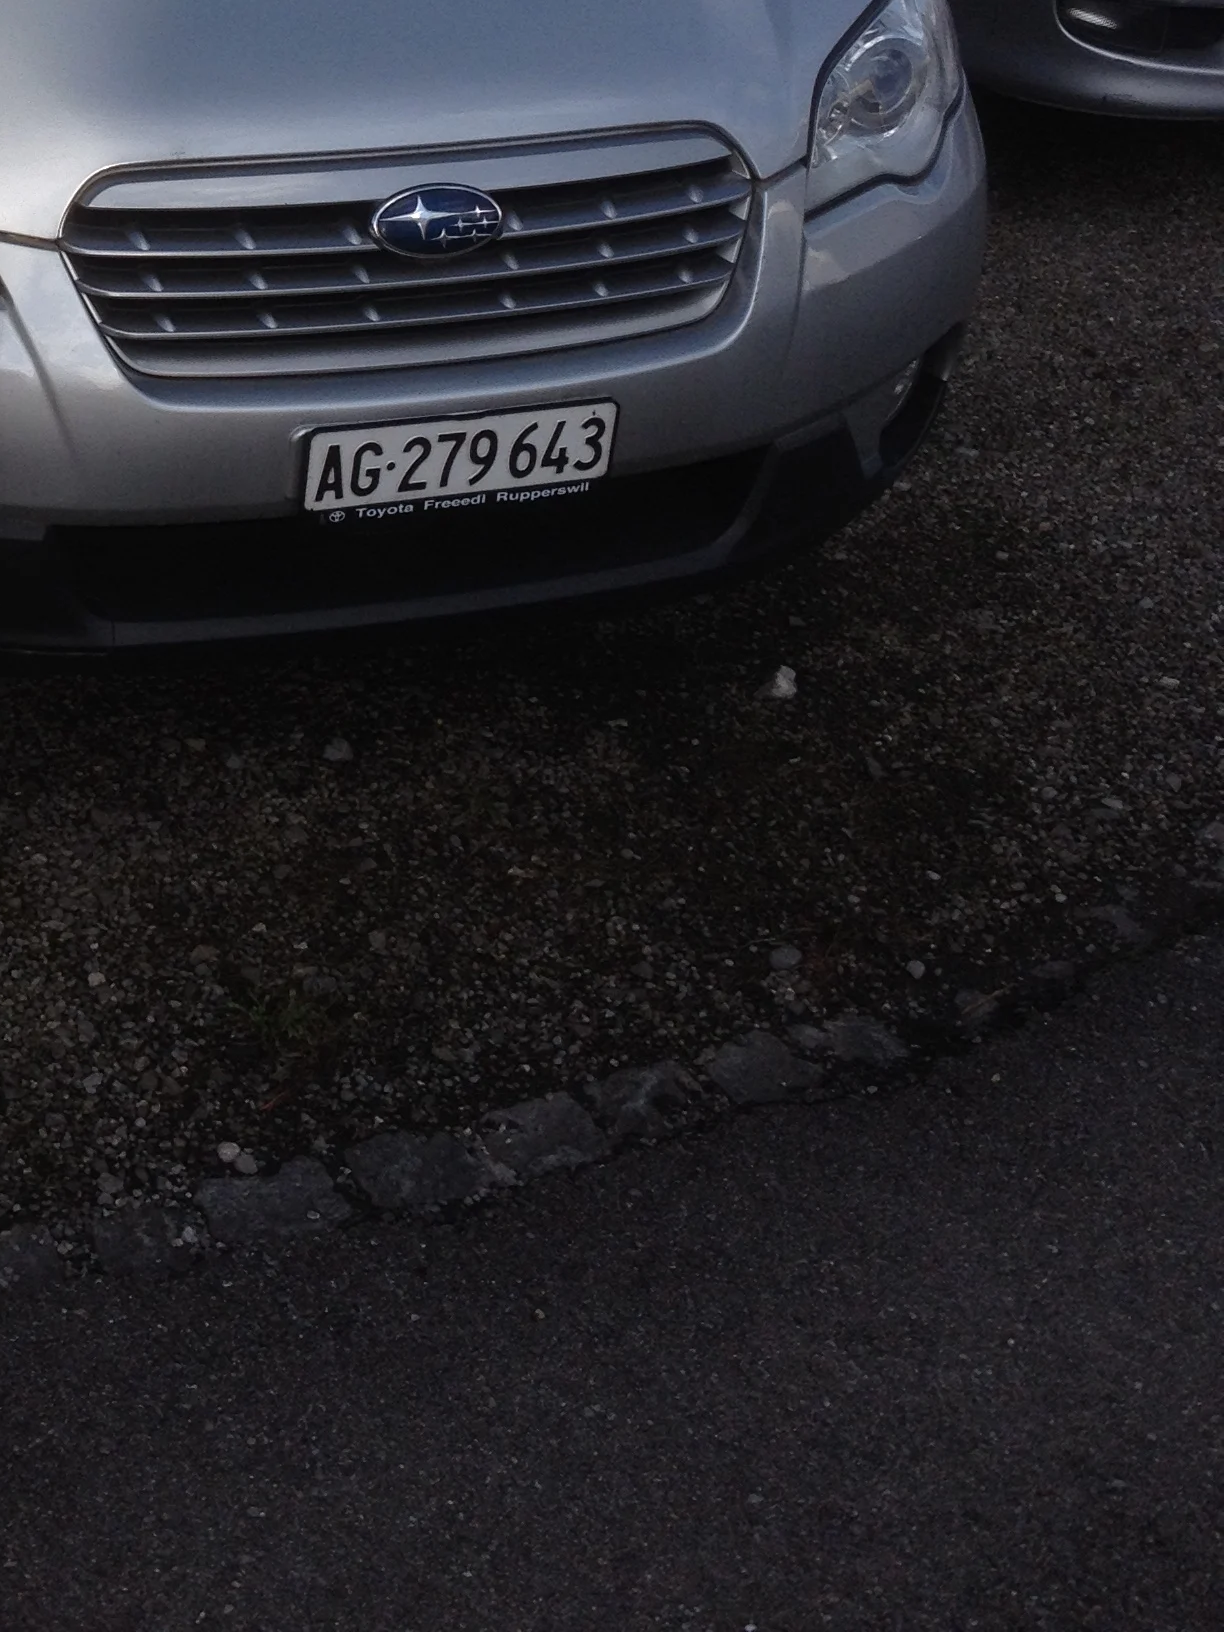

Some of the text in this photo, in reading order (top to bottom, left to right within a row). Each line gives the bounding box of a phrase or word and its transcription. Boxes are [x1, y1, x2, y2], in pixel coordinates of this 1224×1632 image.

[355, 482, 590, 519] Toyota Freeedi Rupperswil
